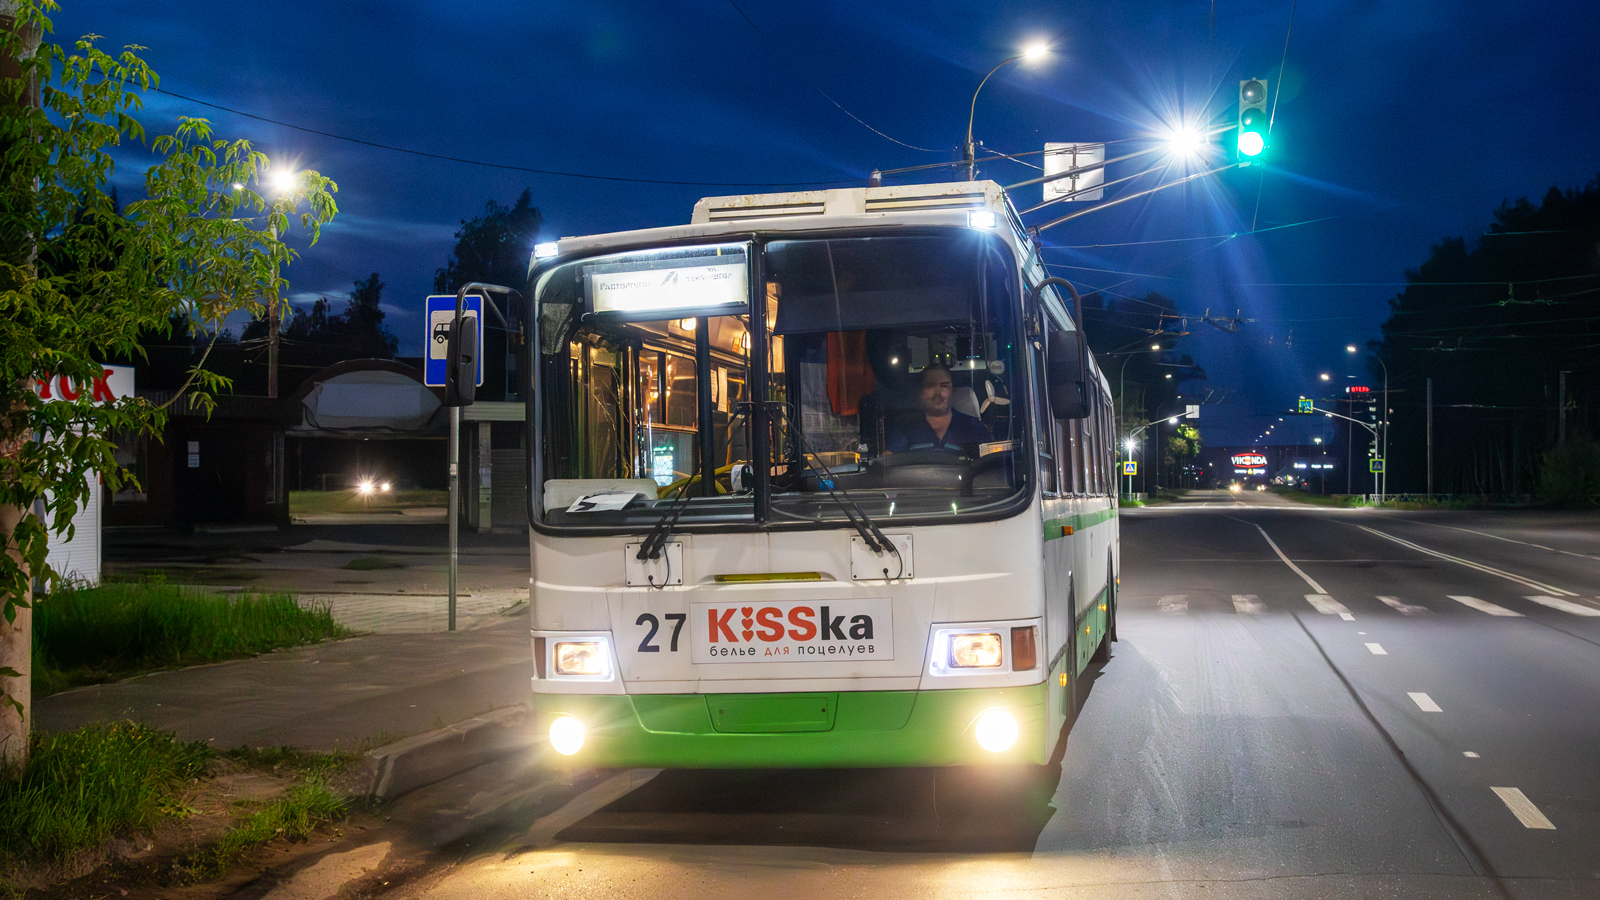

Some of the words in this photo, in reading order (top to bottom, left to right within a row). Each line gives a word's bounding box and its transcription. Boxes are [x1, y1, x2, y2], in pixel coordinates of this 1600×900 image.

[635, 612, 687, 653] 27
[710, 645, 756, 657] белье
[764, 646, 790, 657] для
[797, 644, 875, 656] поцелуев
